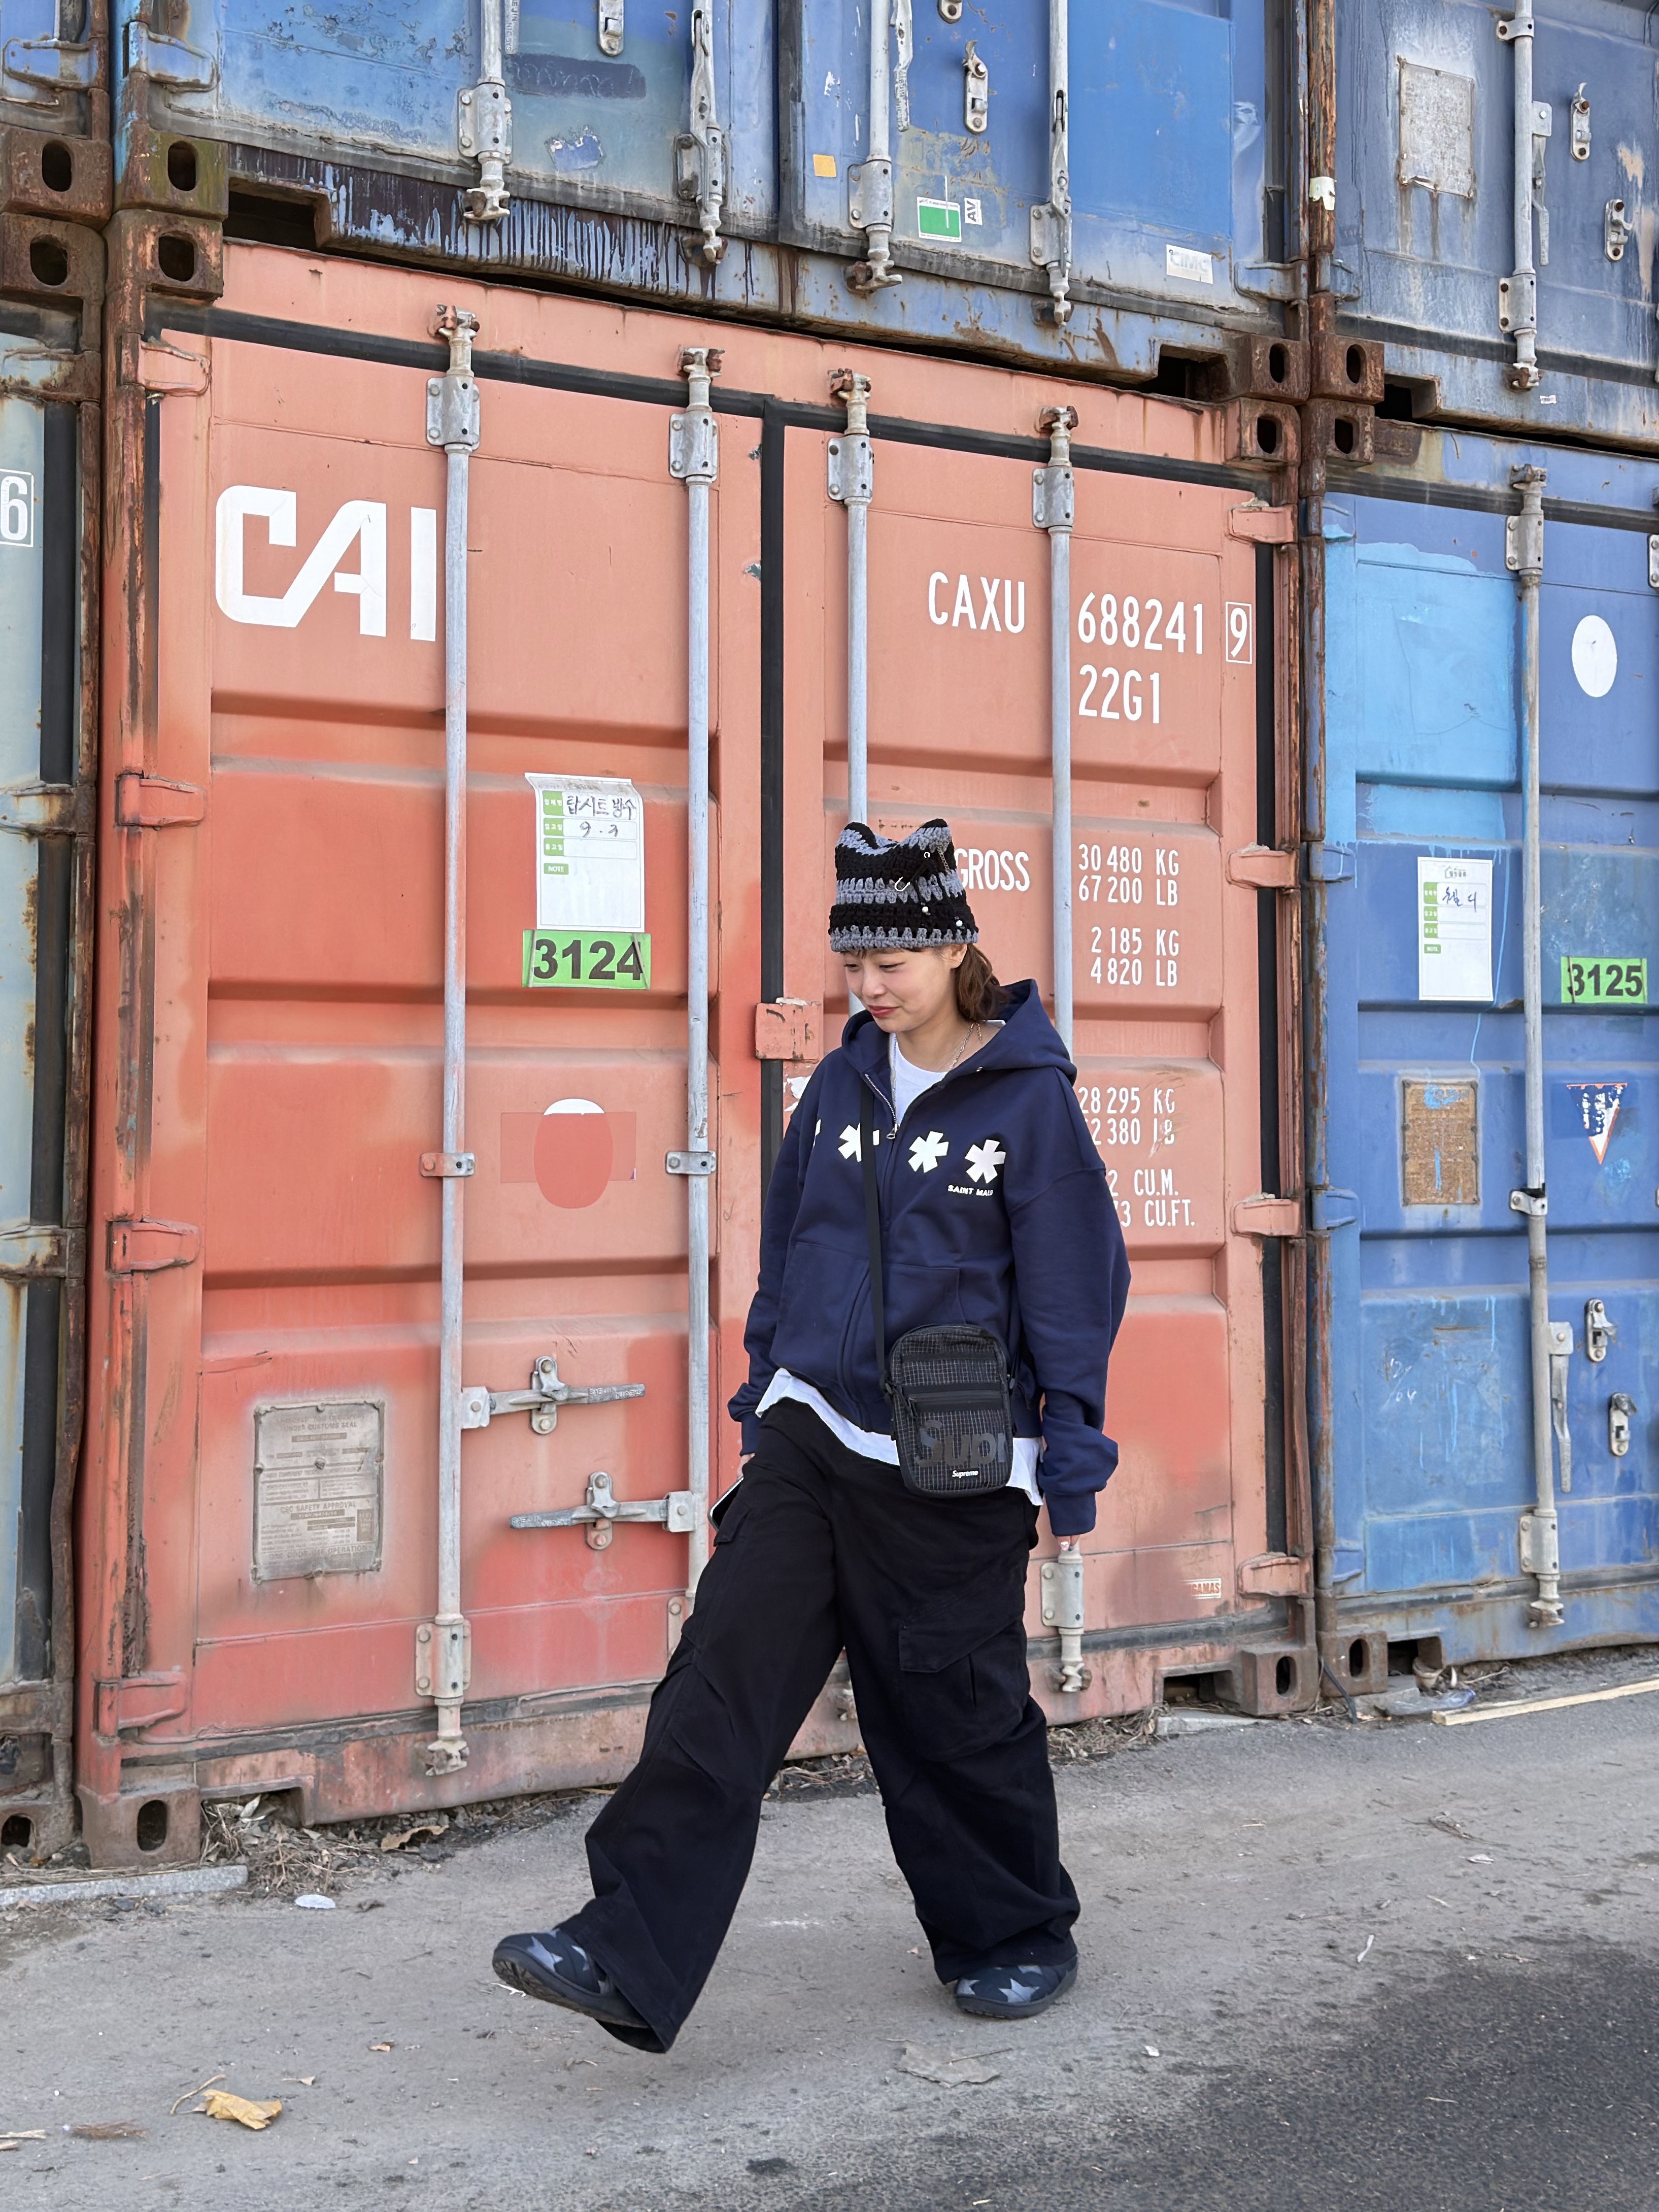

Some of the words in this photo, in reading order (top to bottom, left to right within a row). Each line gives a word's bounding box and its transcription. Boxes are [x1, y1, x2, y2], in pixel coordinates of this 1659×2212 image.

[1, 476, 27, 540] 6
[215, 485, 436, 642] CAI
[928, 572, 1025, 633] CAXU
[1078, 592, 1203, 654] 688241
[1230, 608, 1247, 657] 9
[1078, 664, 1160, 724] 22G1
[954, 848, 1030, 892] GROSS
[1156, 849, 1179, 876] KG
[1156, 879, 1177, 906] LB
[1156, 929, 1179, 956] KG
[533, 939, 644, 981] 3124
[1156, 959, 1177, 987] LB
[1567, 963, 1642, 996] 3125
[947, 1185, 974, 1195] SAINT
[1134, 1168, 1178, 1196] CU.M.
[1145, 1199, 1195, 1227] CU.FT.
[952, 1470, 979, 1479] Supreme
[296, 1503, 320, 1512] SAFETY
[323, 1501, 356, 1510] APPROVAL
